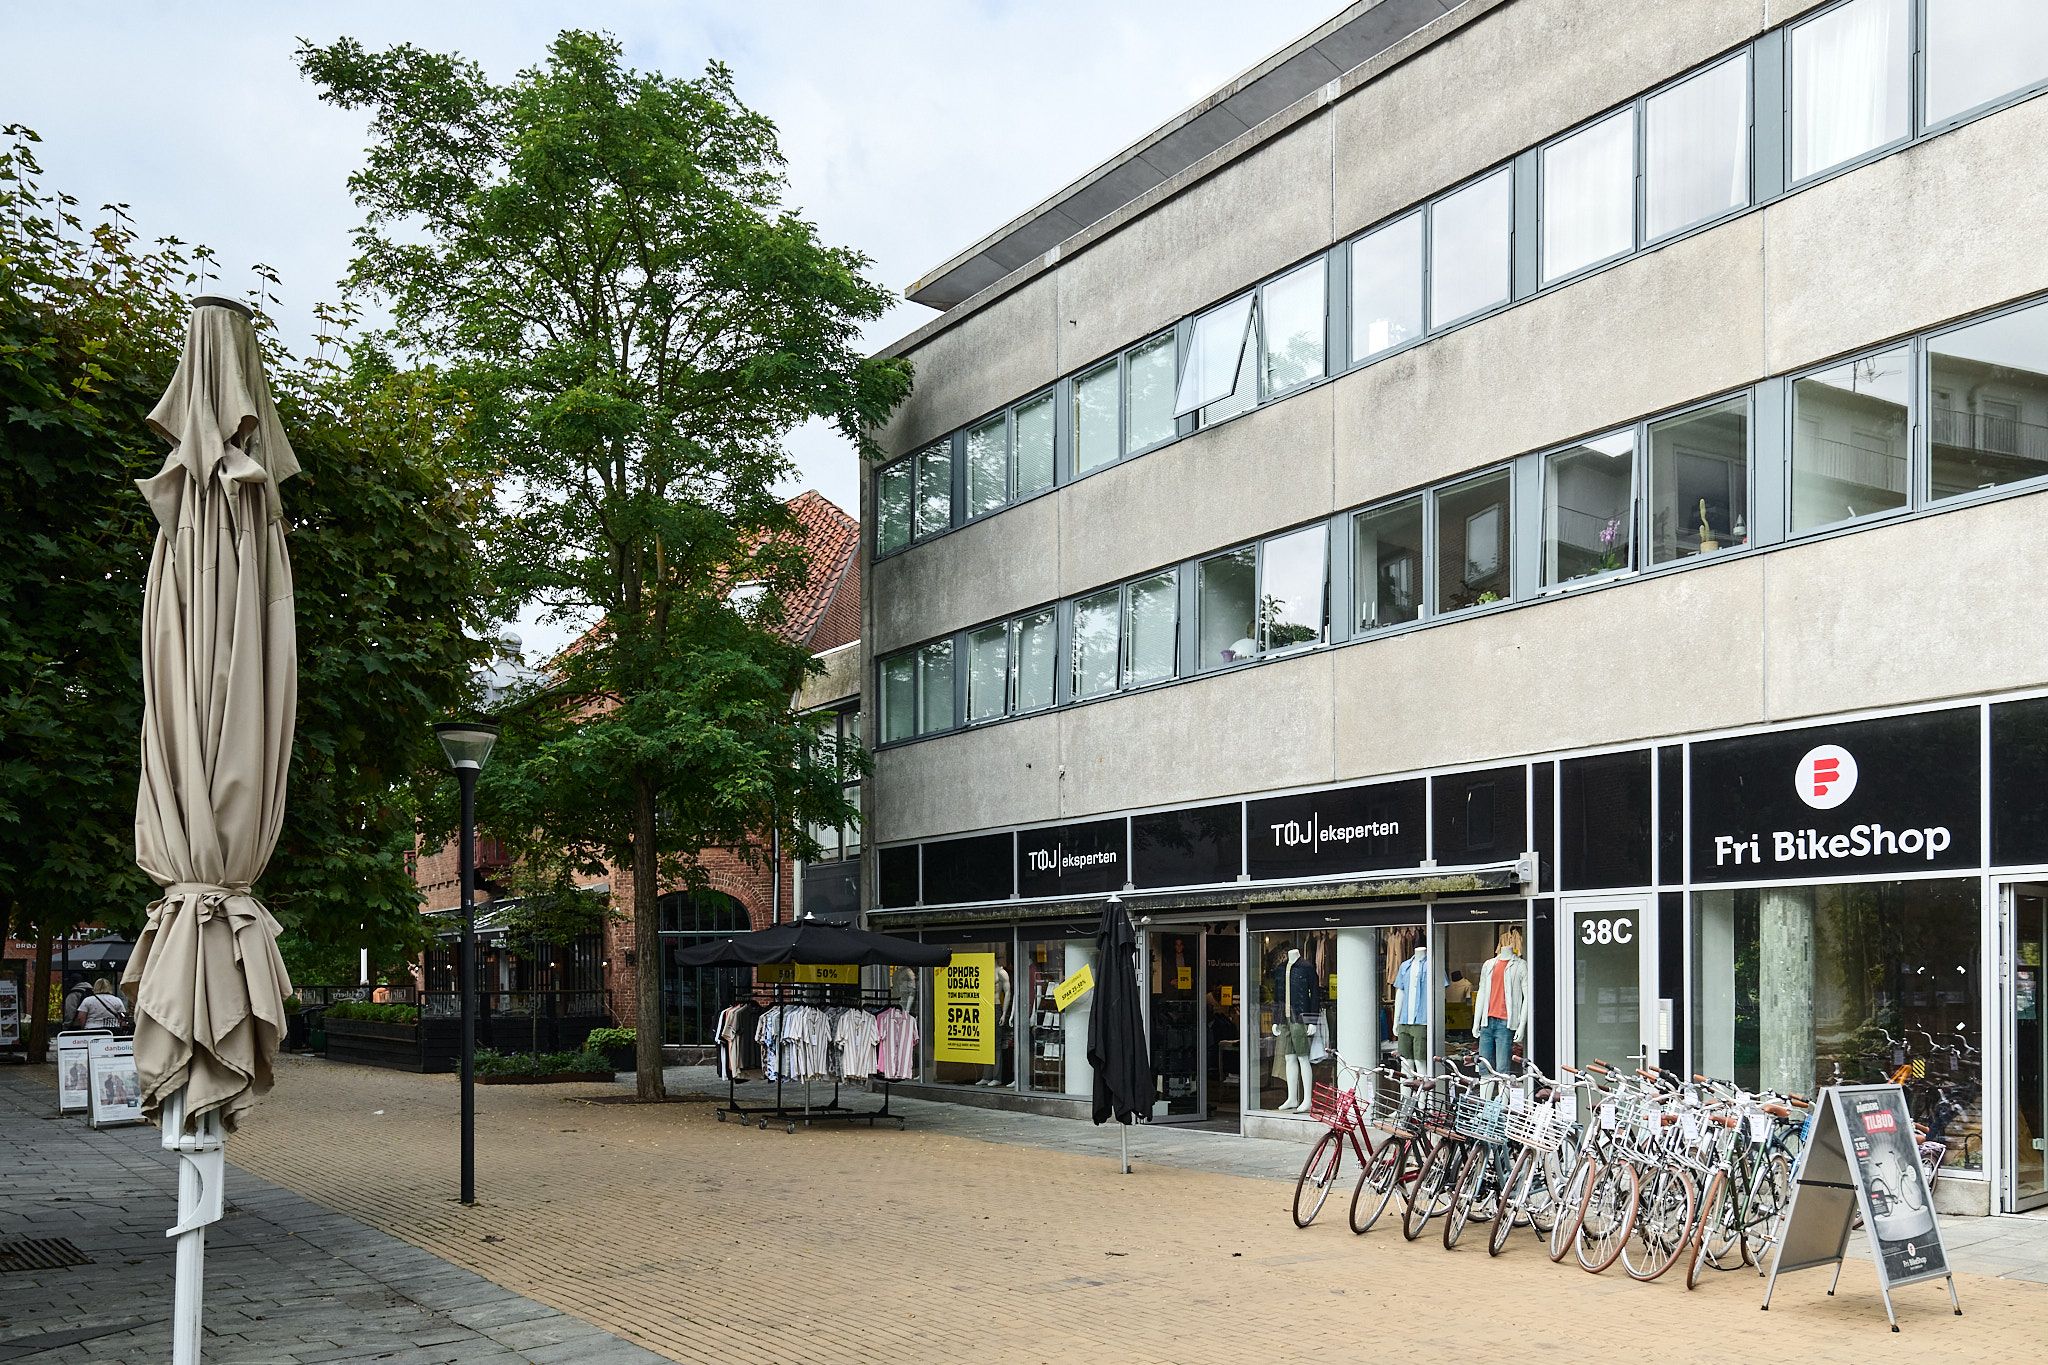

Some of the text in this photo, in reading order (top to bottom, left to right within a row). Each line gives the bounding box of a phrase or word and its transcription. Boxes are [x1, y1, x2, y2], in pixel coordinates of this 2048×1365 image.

[1270, 820, 1399, 846] TØJ eksperten
[1715, 823, 1951, 866] Fri BikeShop
[1028, 848, 1117, 871] TØJ eksperten
[1581, 917, 1633, 945] 38C
[816, 967, 838, 979] 50%
[947, 966, 980, 978] OPHØRS
[947, 977, 980, 990] UDSALG
[947, 1007, 980, 1024] SPAR
[947, 1024, 980, 1037] 25-70%
[1864, 1113, 1894, 1131] TILBUD
